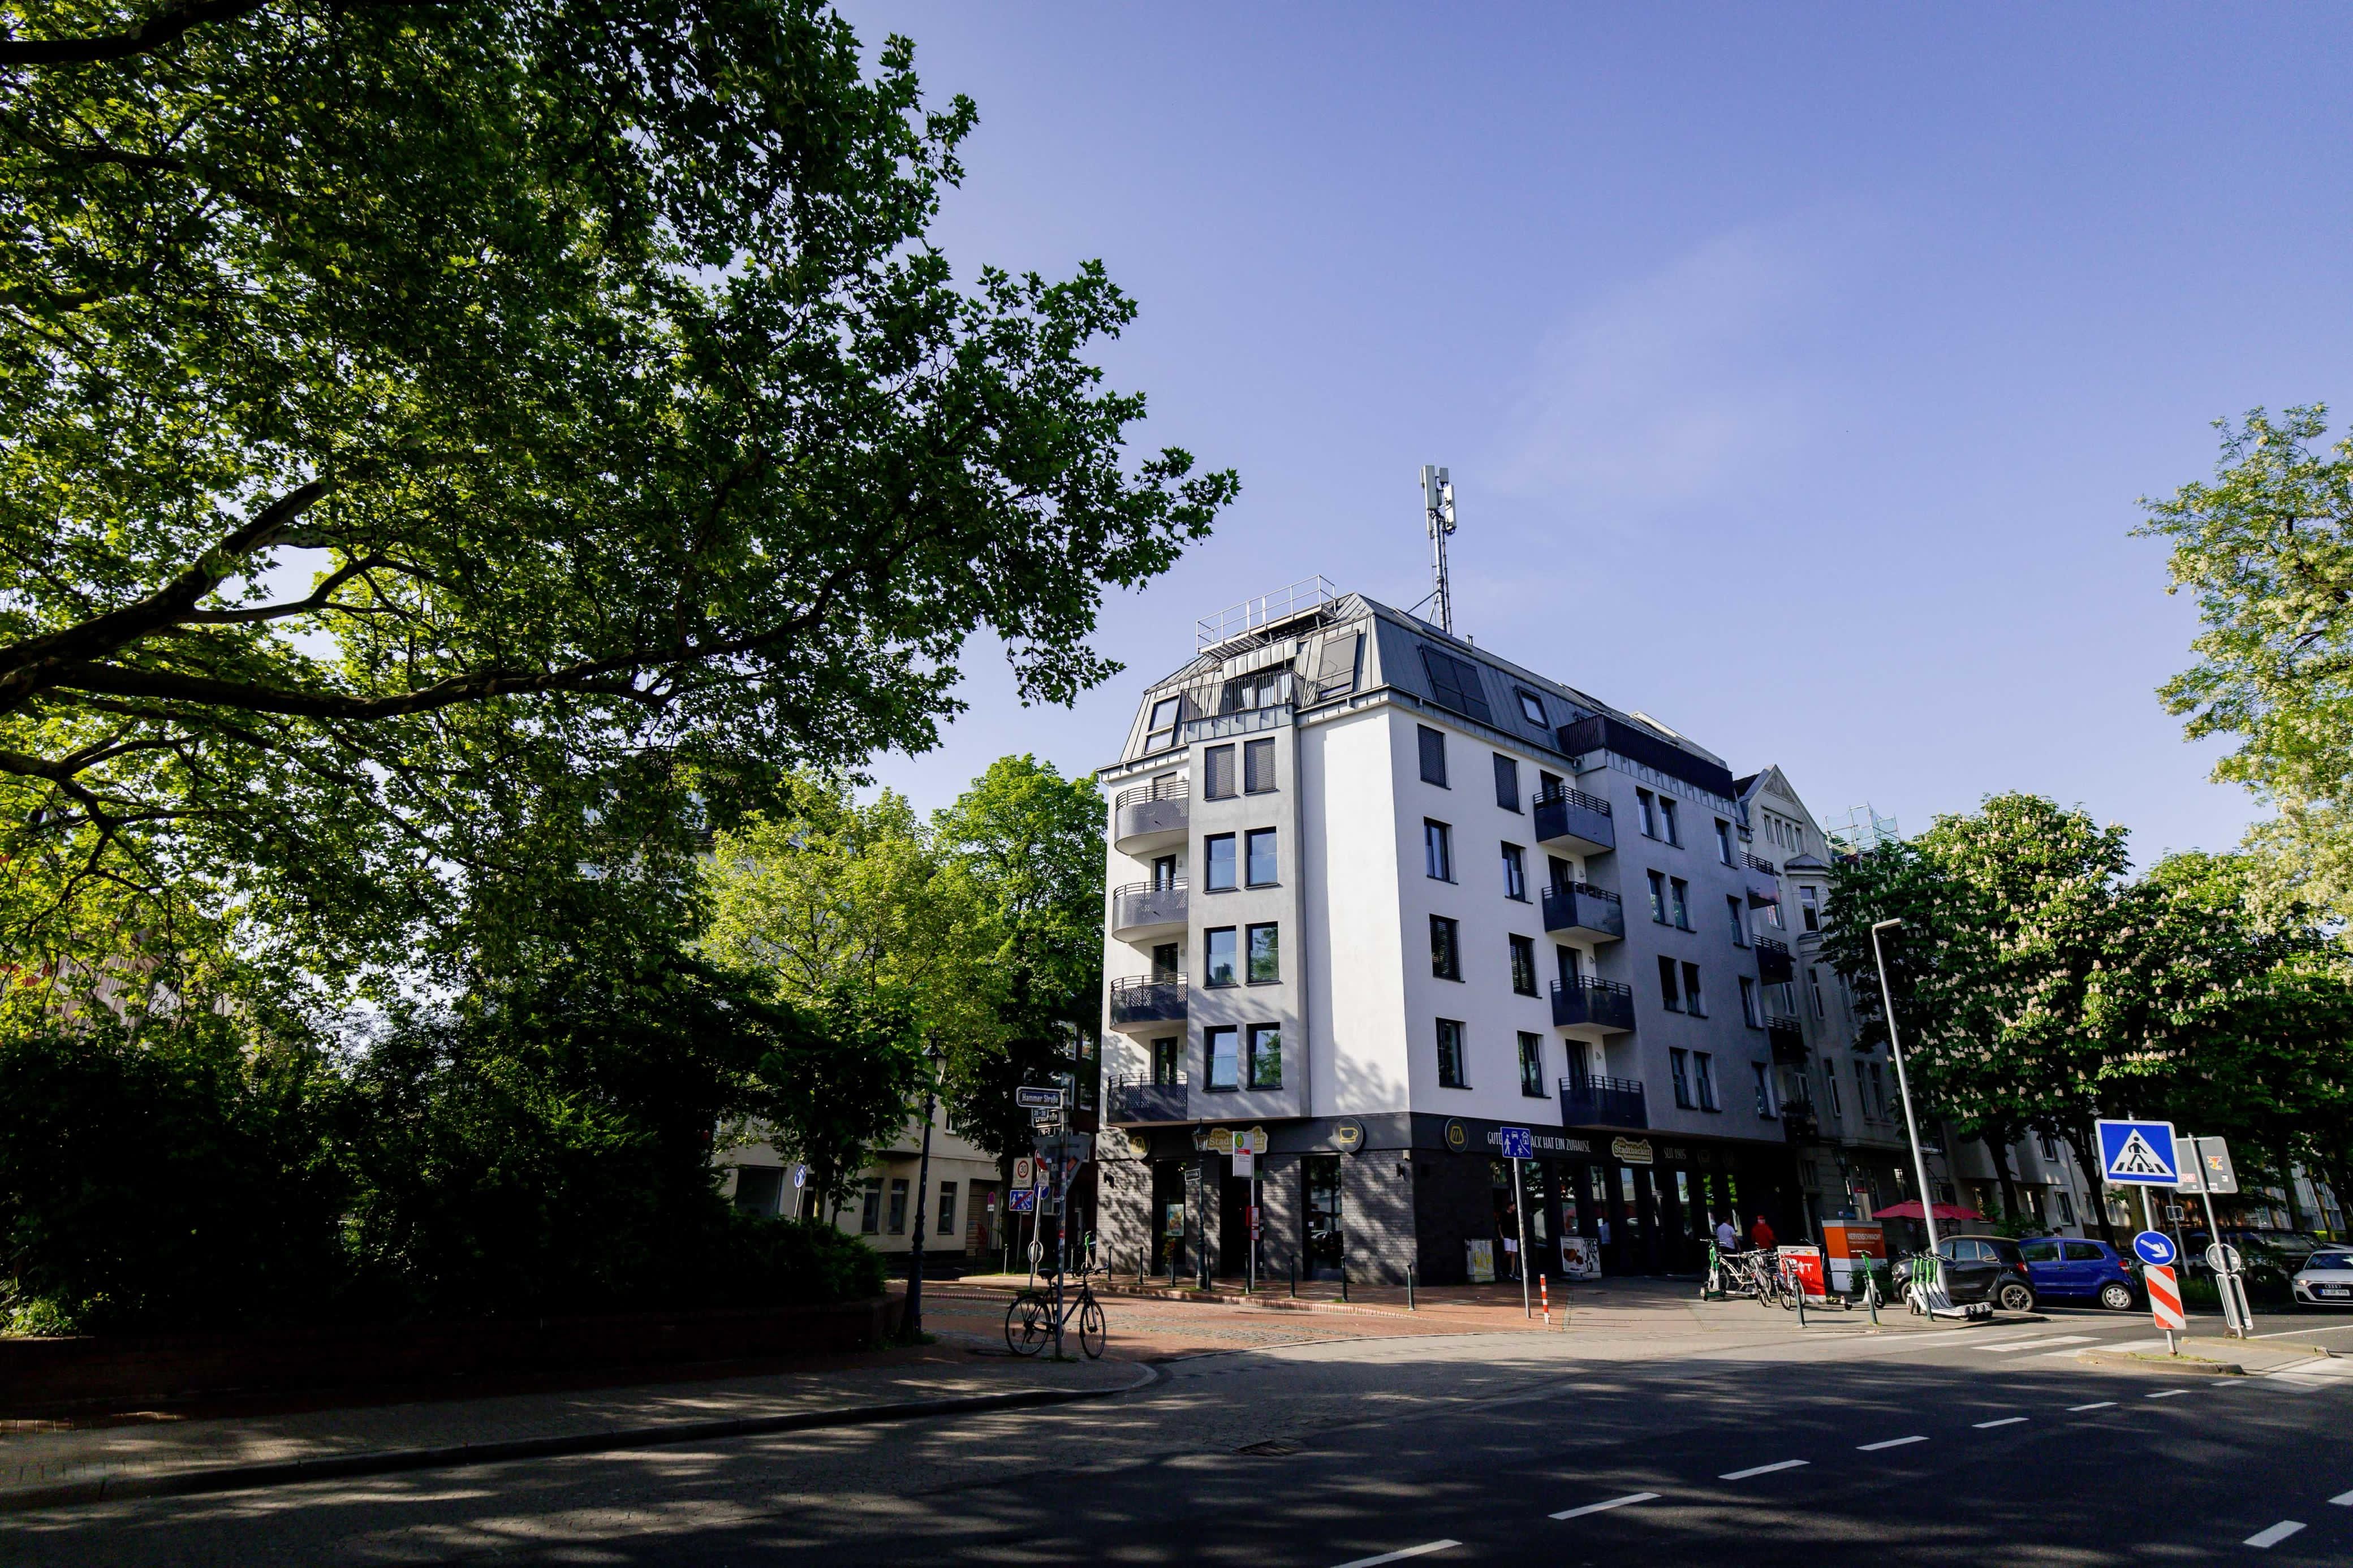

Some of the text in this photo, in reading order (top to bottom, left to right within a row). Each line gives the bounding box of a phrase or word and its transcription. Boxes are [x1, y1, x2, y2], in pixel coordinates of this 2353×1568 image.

[1022, 1092, 1058, 1104] Hammer Straße
[1488, 1131, 1503, 1145] GUTE
[1543, 1137, 1554, 1150] HAT
[1555, 1138, 1565, 1150] EIN
[1566, 1139, 1591, 1152] ZUHAUSE
